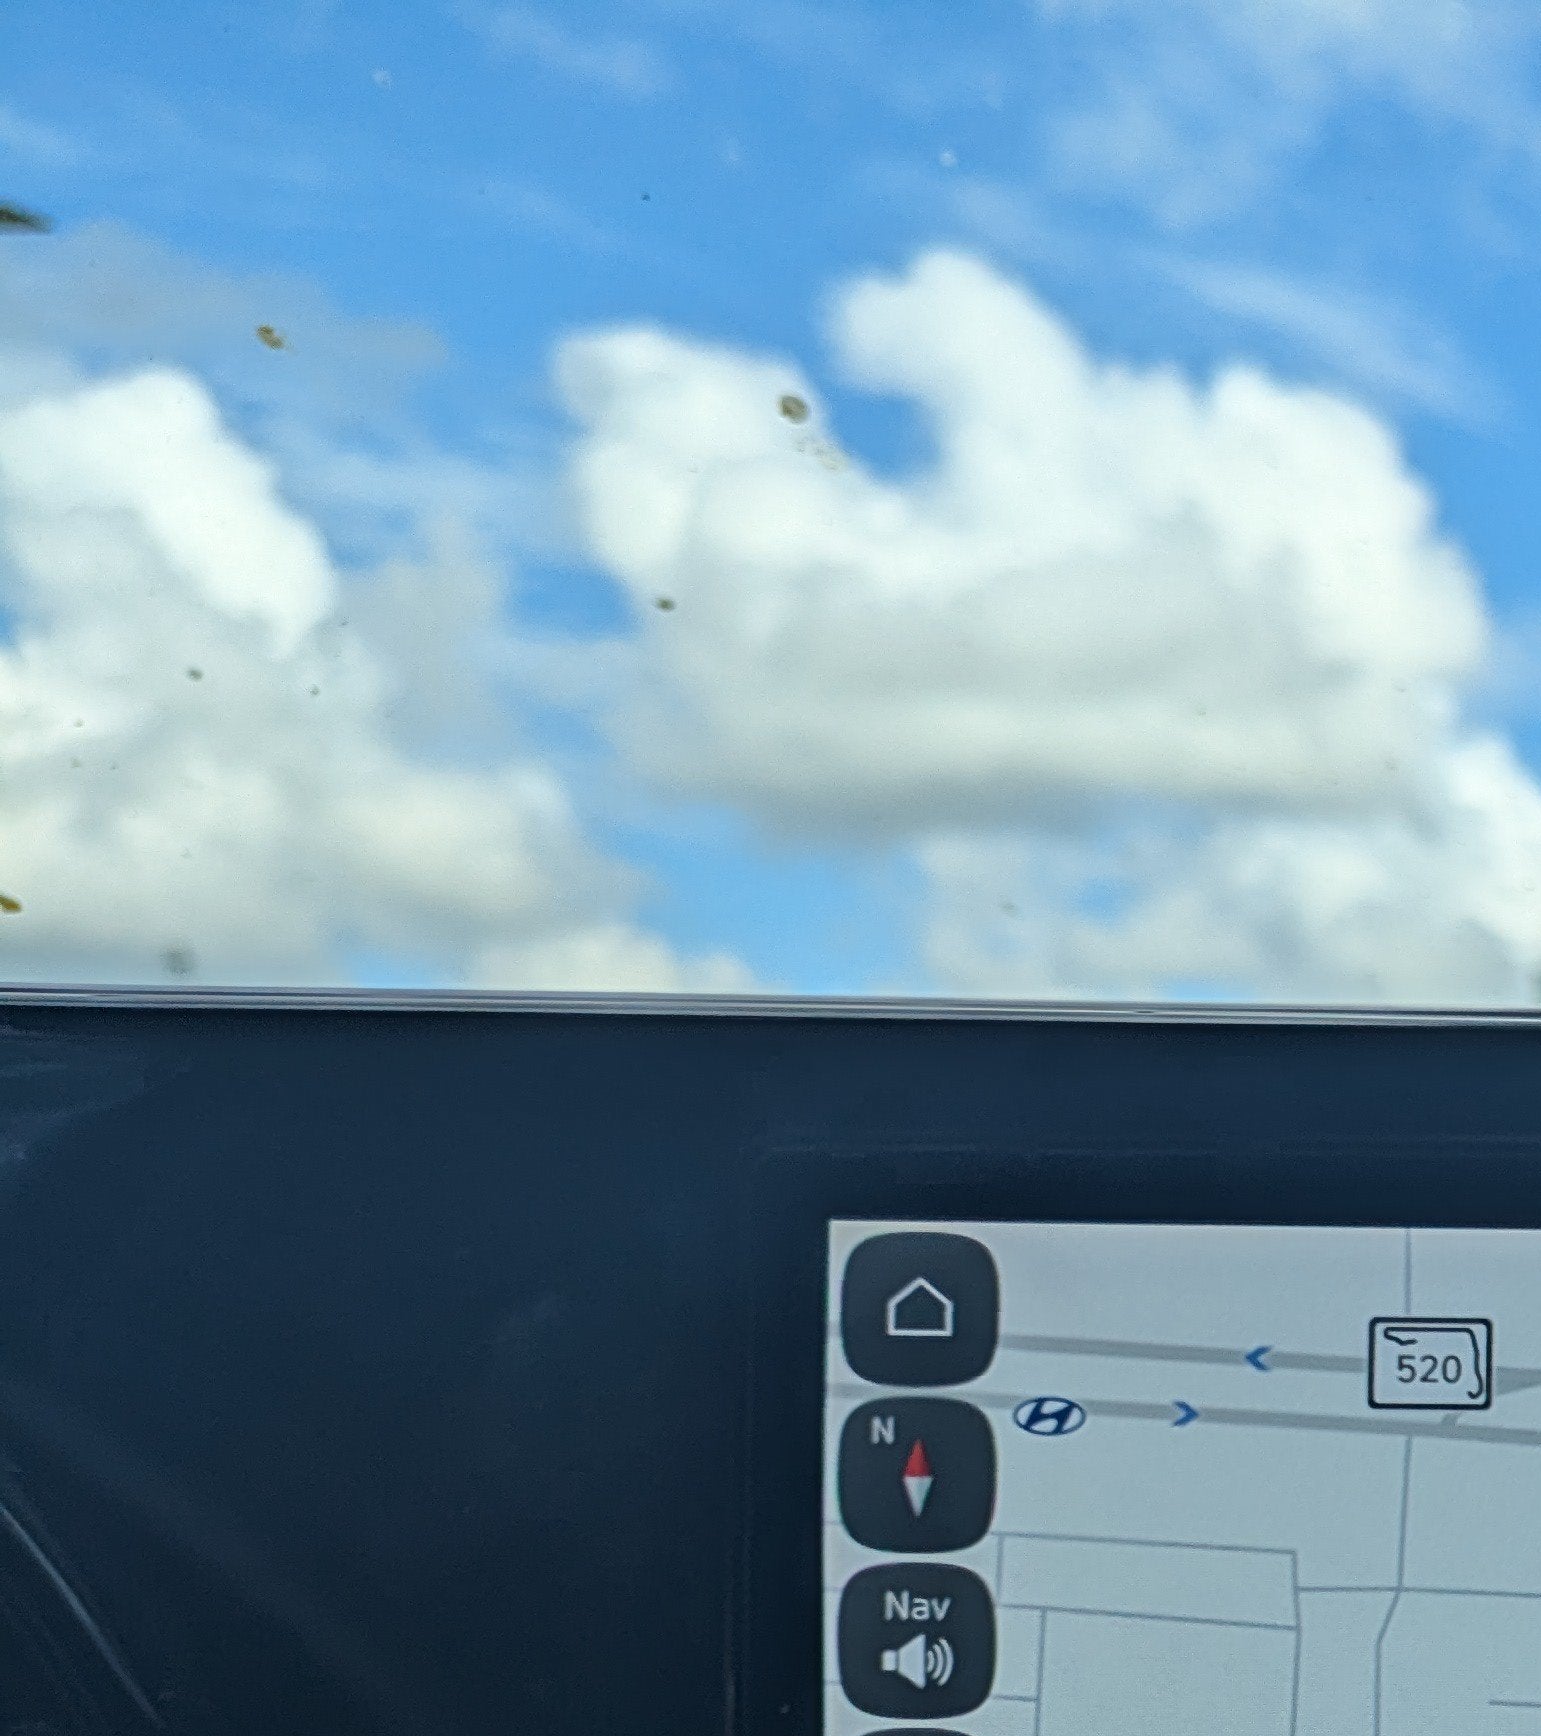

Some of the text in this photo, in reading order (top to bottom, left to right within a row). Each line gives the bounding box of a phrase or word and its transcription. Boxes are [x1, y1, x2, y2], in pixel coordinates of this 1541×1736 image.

[1395, 1354, 1463, 1386] 520
[871, 1416, 895, 1444] N
[884, 1589, 952, 1623] Nav
